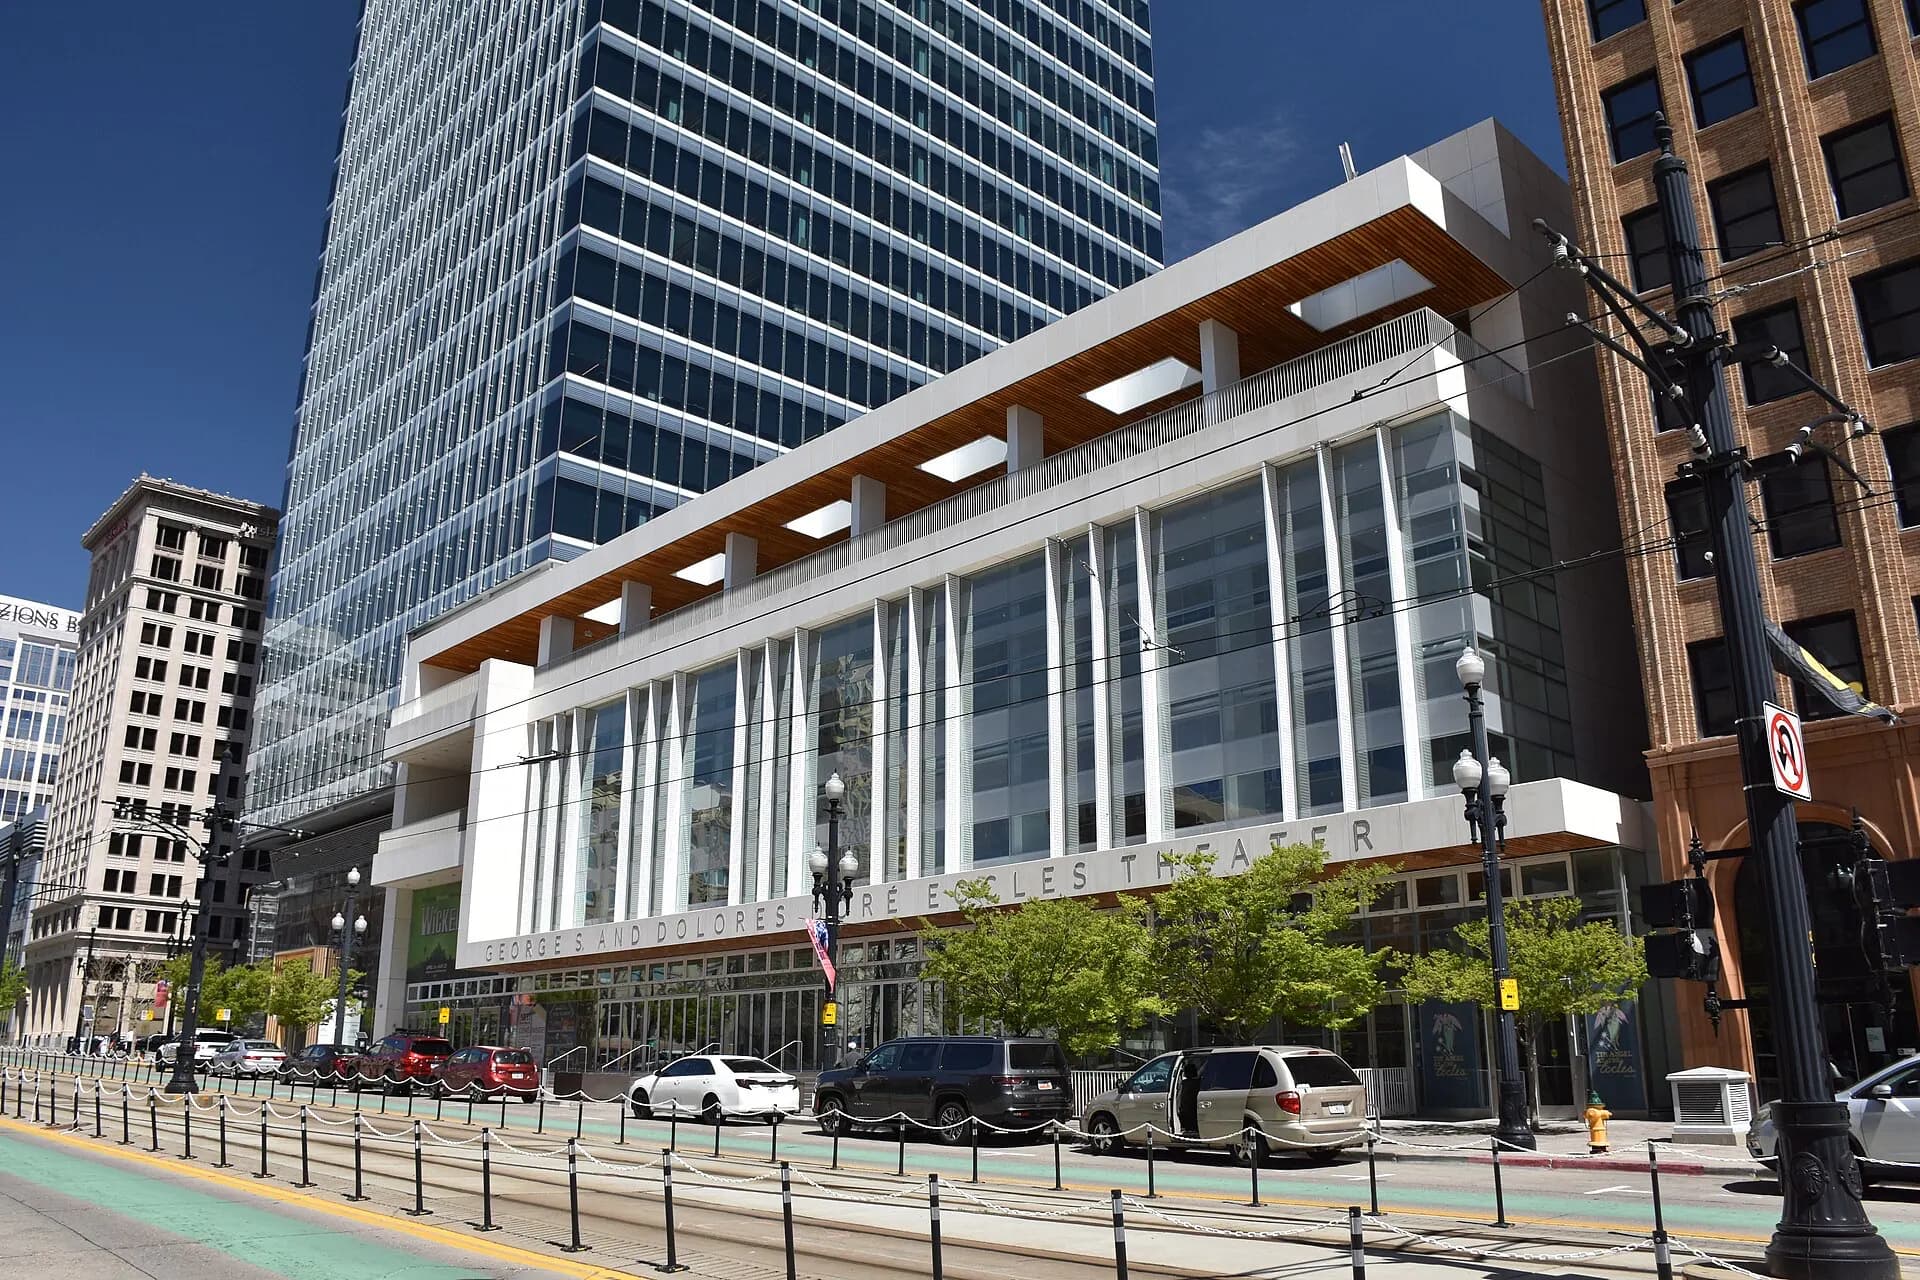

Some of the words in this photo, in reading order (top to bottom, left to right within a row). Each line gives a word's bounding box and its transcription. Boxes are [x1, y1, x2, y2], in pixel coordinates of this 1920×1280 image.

[0, 602, 59, 630] ZIONS
[421, 905, 459, 936] WICKE
[485, 935, 562, 962] GEORGE
[598, 925, 640, 950] AND
[657, 904, 785, 943] DOLORES
